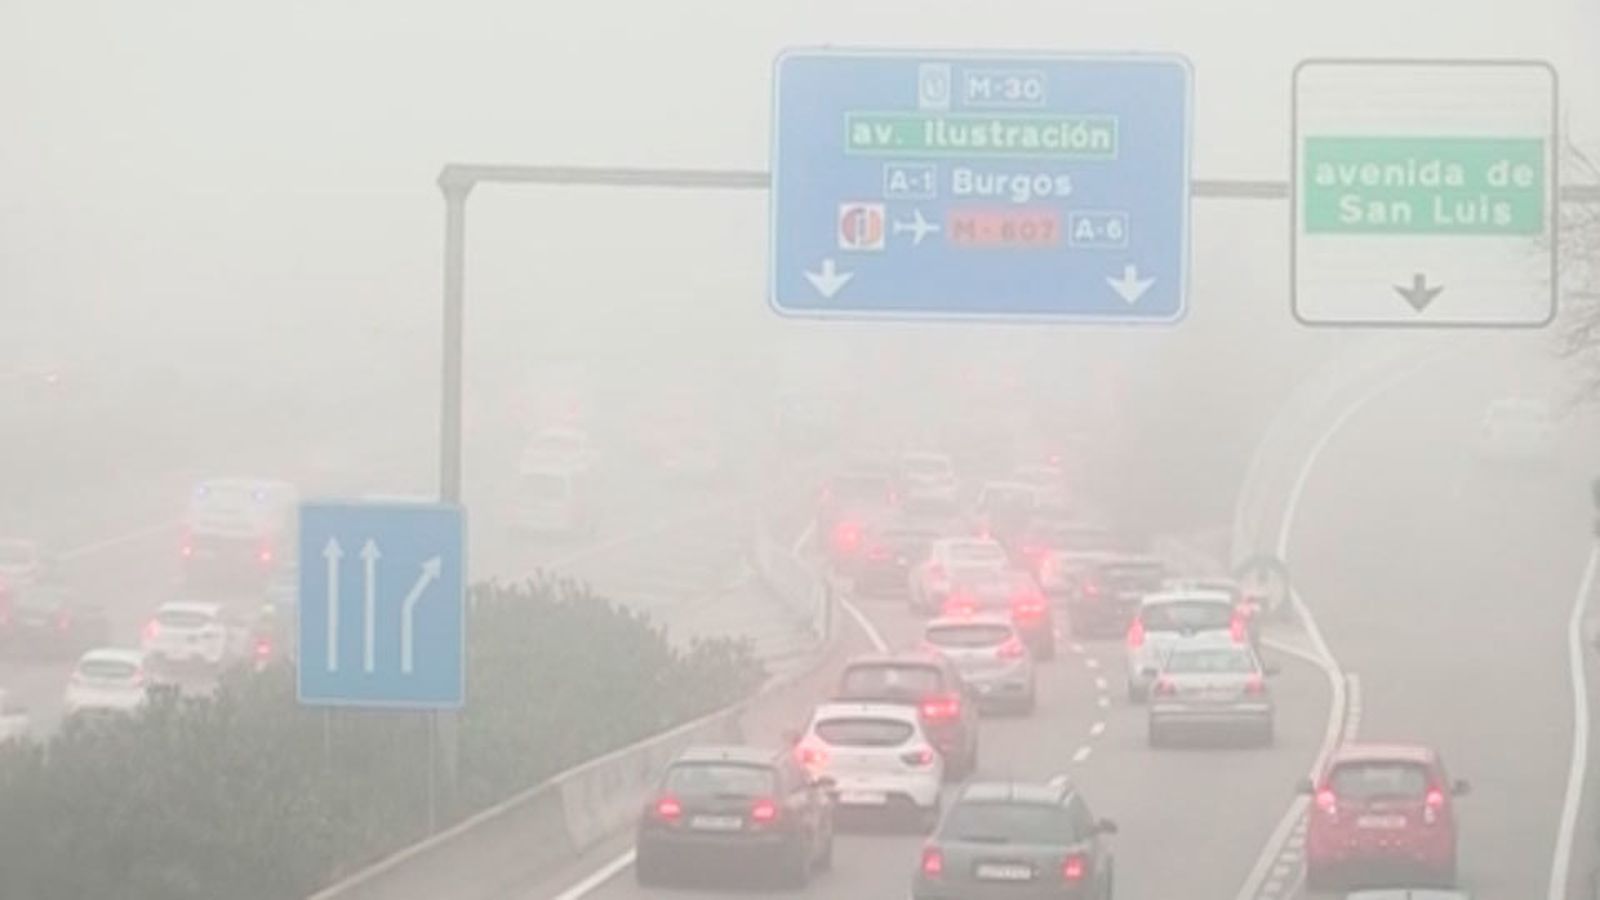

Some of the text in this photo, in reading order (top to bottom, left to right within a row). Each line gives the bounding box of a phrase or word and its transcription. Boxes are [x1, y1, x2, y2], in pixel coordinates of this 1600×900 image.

[969, 76, 1041, 99] M-30
[852, 119, 1111, 148] av. Ilustración
[889, 168, 1073, 202] A-1 Burgos
[1315, 158, 1535, 188] avenida de
[1338, 193, 1512, 225] San Luis
[1074, 218, 1123, 241] A-6
